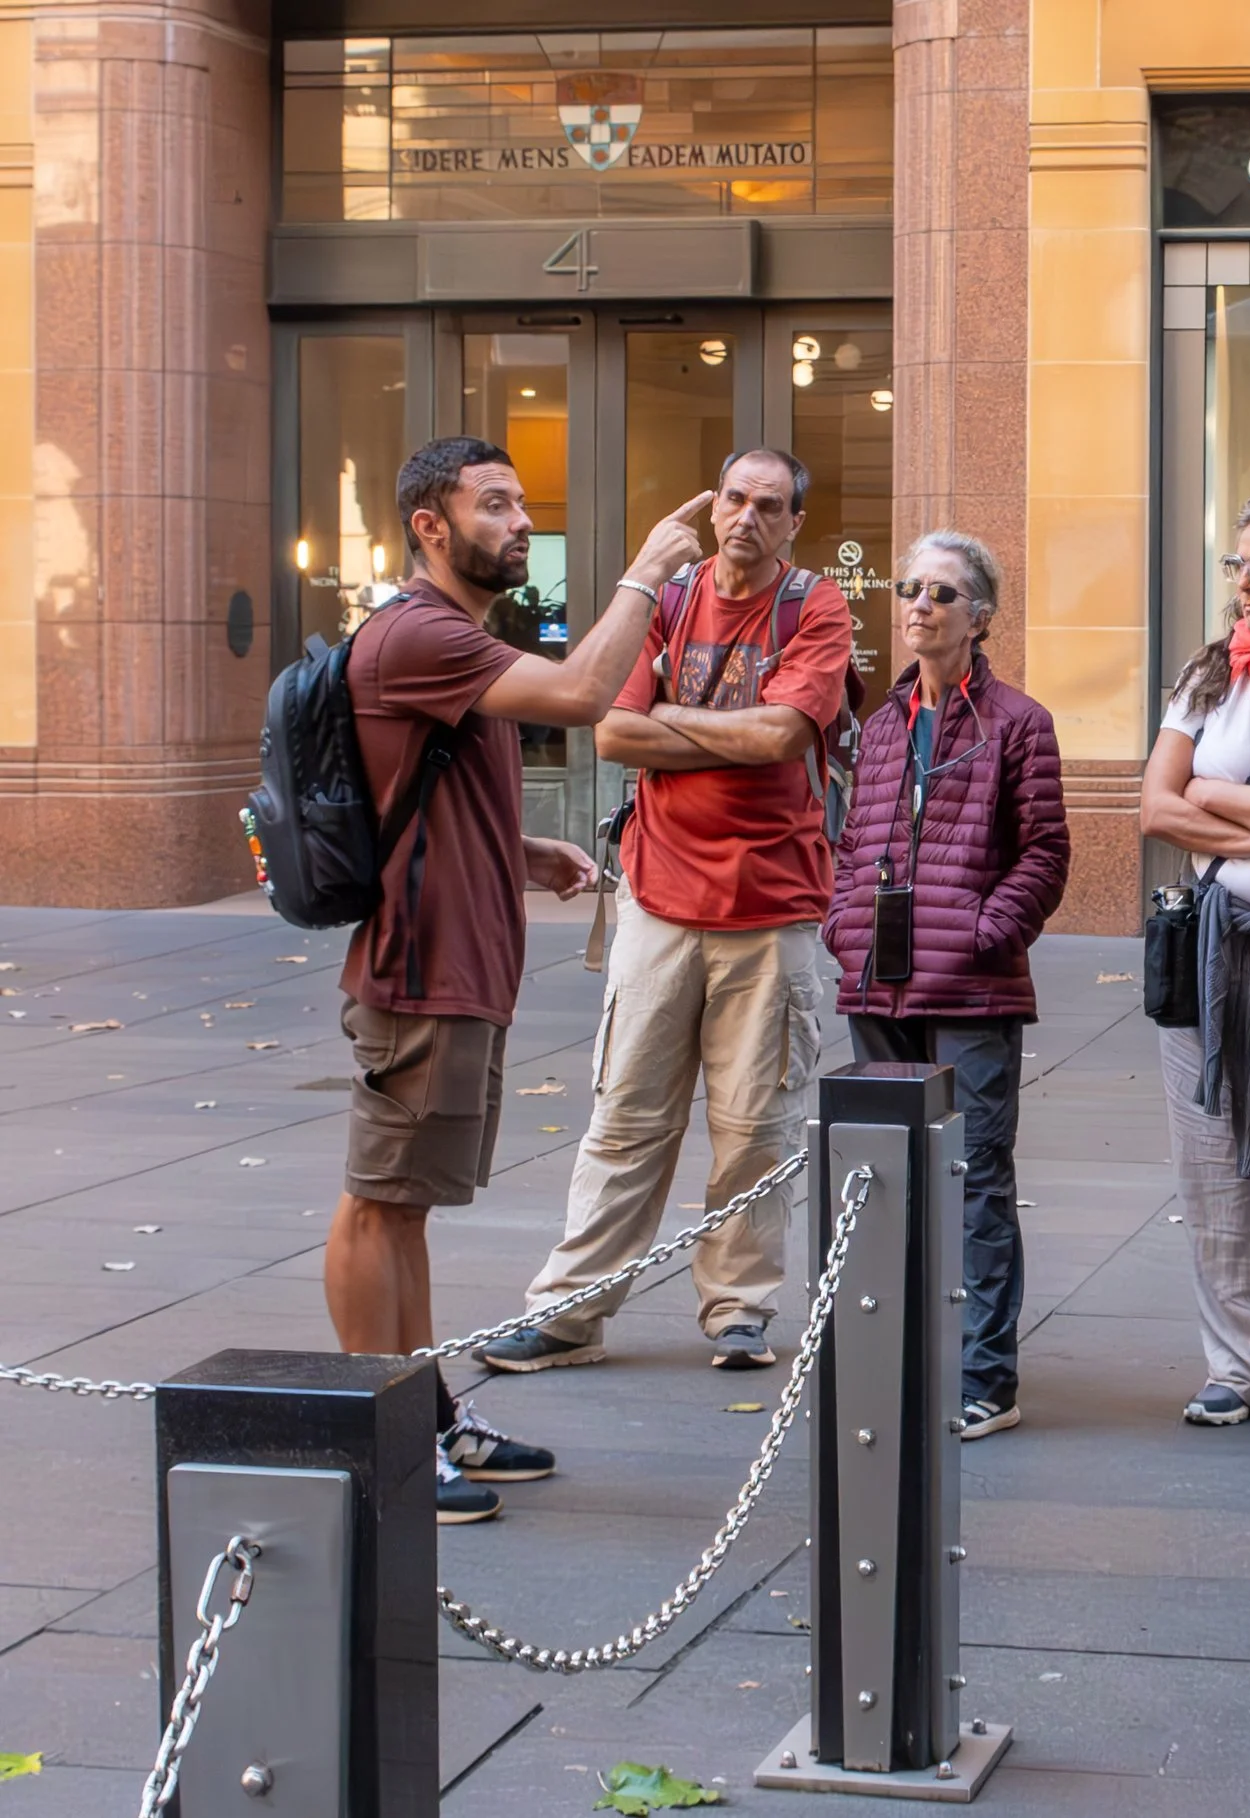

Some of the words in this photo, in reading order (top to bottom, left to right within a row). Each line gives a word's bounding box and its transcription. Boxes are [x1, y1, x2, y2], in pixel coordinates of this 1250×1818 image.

[497, 147, 570, 169] MENS
[628, 144, 706, 167] EADEM
[715, 142, 806, 166] MUTATO
[542, 228, 599, 292] 4
[822, 566, 850, 578] THIS
[852, 566, 864, 577] IS
[867, 567, 876, 577] A
[842, 589, 866, 600] REA
